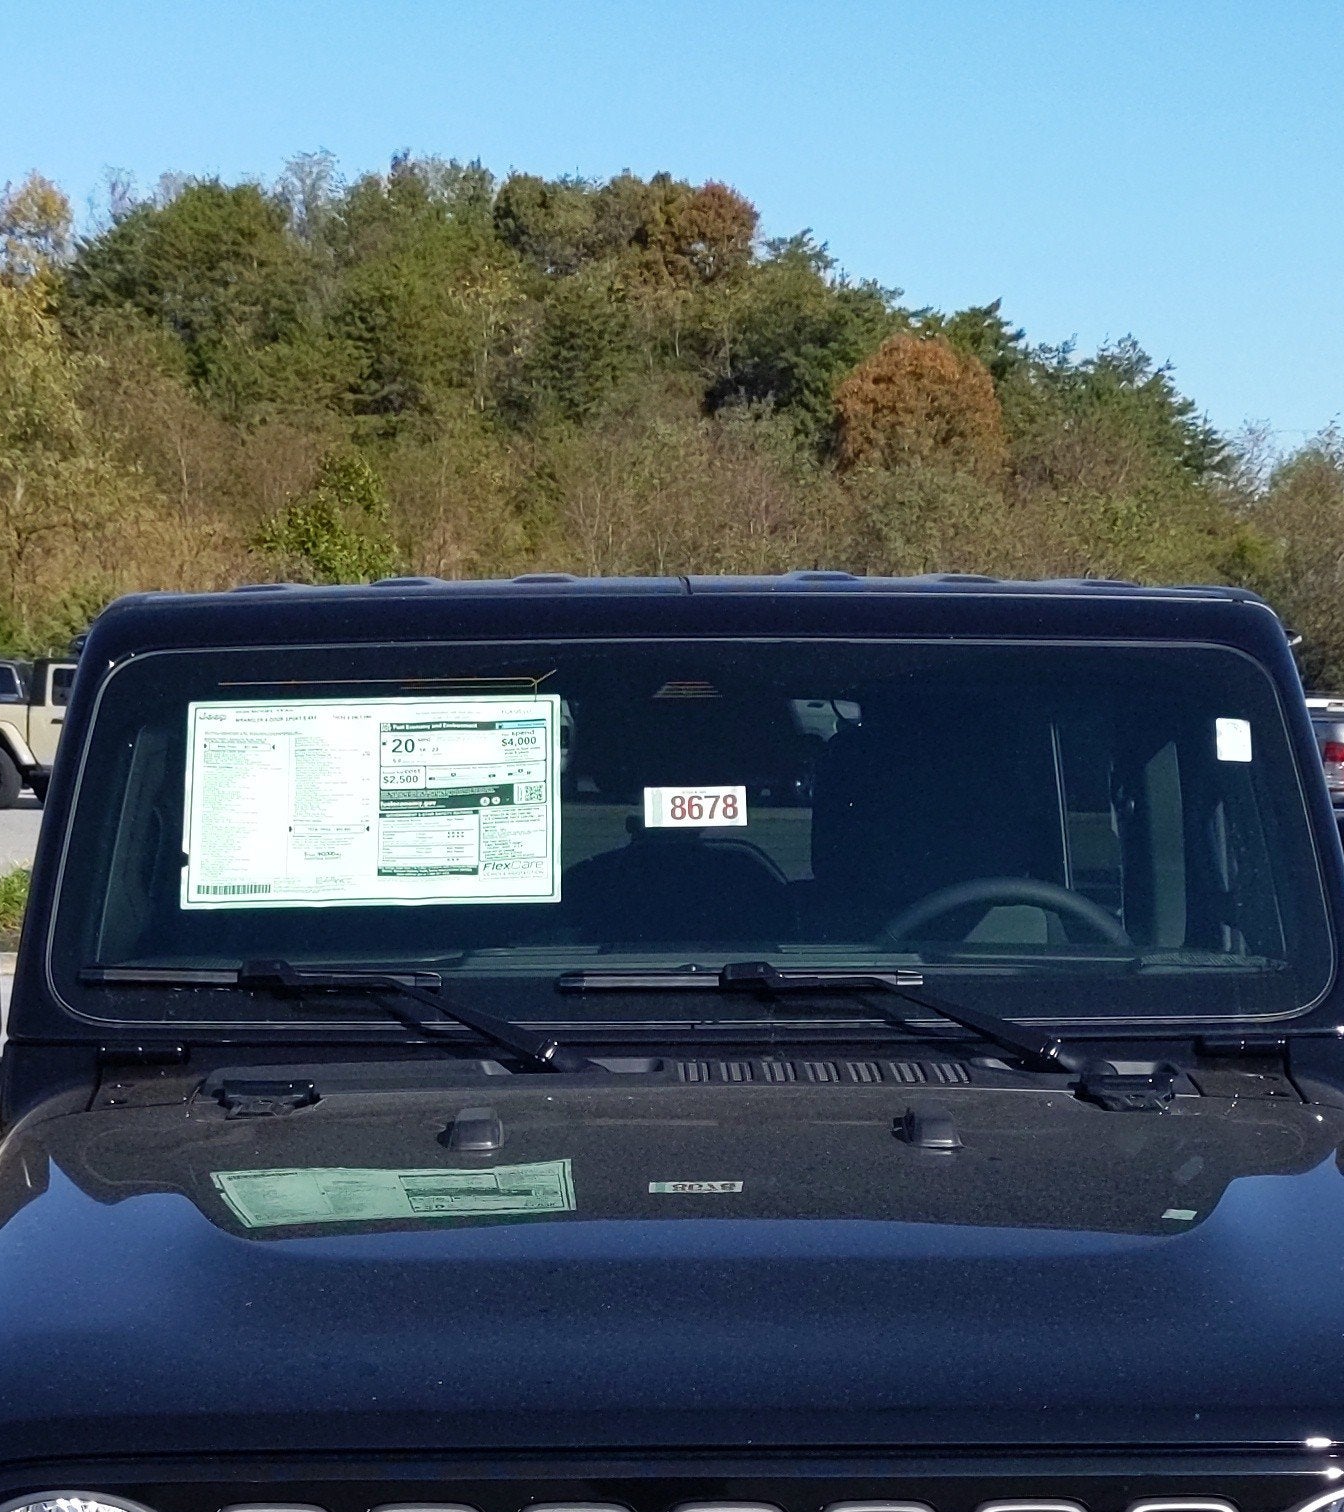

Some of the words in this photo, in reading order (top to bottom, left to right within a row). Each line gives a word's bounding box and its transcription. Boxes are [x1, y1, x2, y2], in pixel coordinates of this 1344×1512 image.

[392, 738, 415, 754] 20
[501, 736, 537, 747] $4,000
[383, 775, 419, 784] $2,500
[670, 794, 739, 821] 8678
[483, 860, 544, 871] FlexCare
